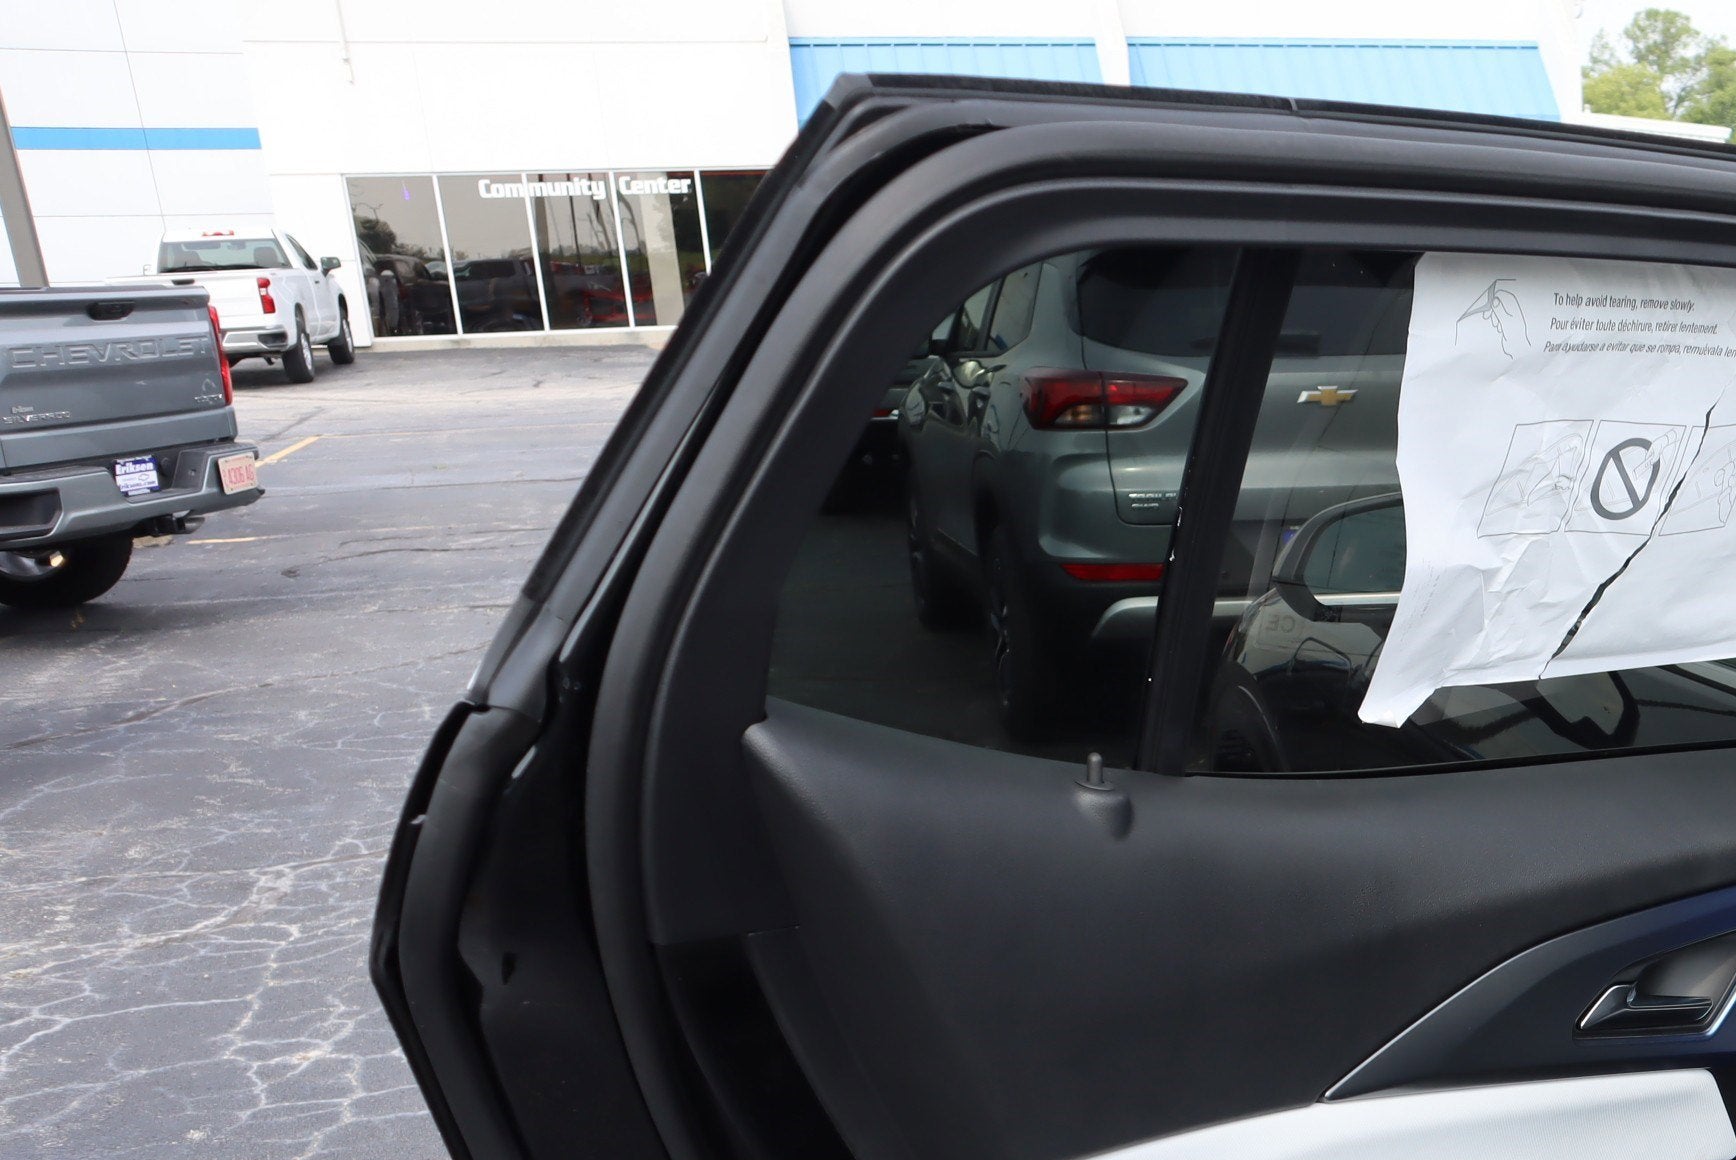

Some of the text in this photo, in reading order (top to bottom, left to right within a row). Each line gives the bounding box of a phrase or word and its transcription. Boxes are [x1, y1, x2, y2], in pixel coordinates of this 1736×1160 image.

[478, 176, 692, 199] Community Center
[1554, 292, 1695, 313] To help avoid tearing, remove slowly.
[1550, 317, 1568, 330] Pour
[1569, 317, 1595, 331] éviter
[1595, 318, 1616, 331] toute
[1617, 319, 1653, 333] déchirure,
[1655, 321, 1678, 332] retirer
[11, 336, 209, 369] CHEVROLET
[1606, 341, 1629, 352] evitar
[1629, 343, 1645, 354] que
[1646, 344, 1657, 353] se
[115, 461, 154, 476] Eriksen
